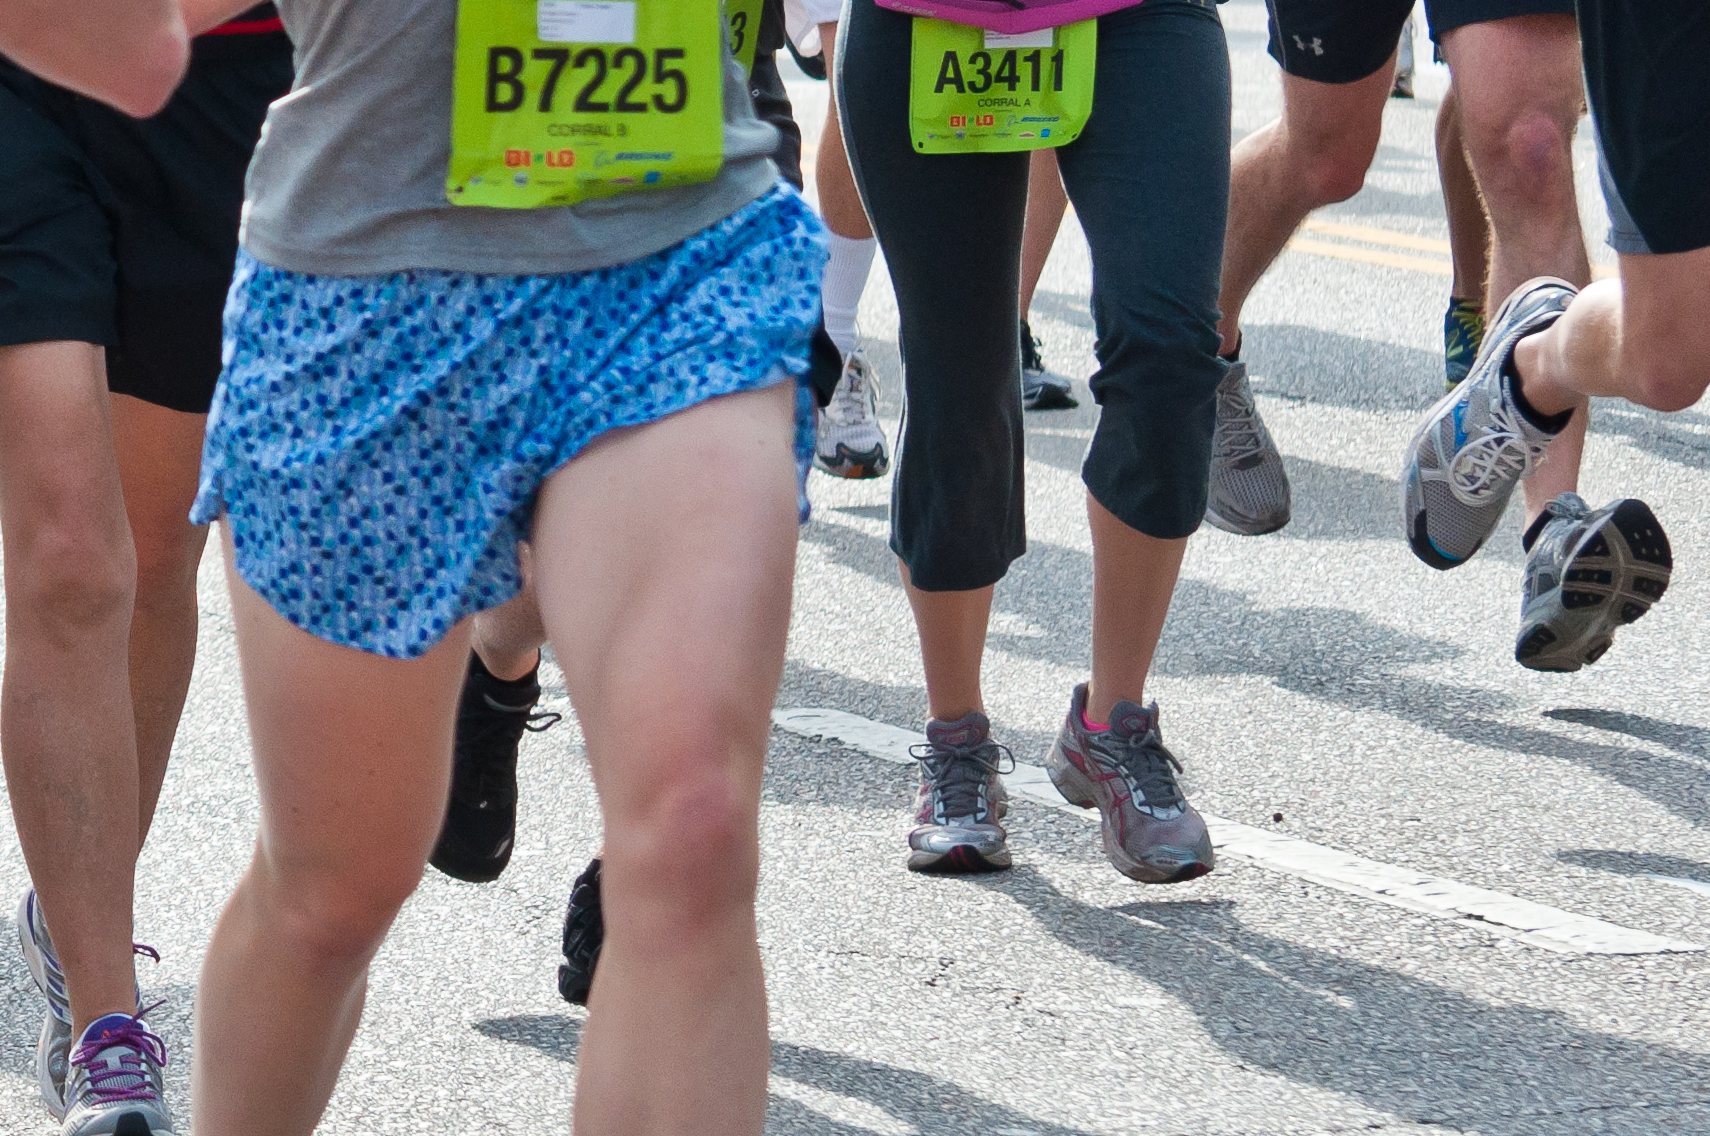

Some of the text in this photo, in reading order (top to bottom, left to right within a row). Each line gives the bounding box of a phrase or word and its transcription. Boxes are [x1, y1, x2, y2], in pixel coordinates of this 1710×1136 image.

[484, 46, 688, 114] B7225
[933, 49, 1065, 94] A3411
[978, 98, 1031, 107] CORRAL A
